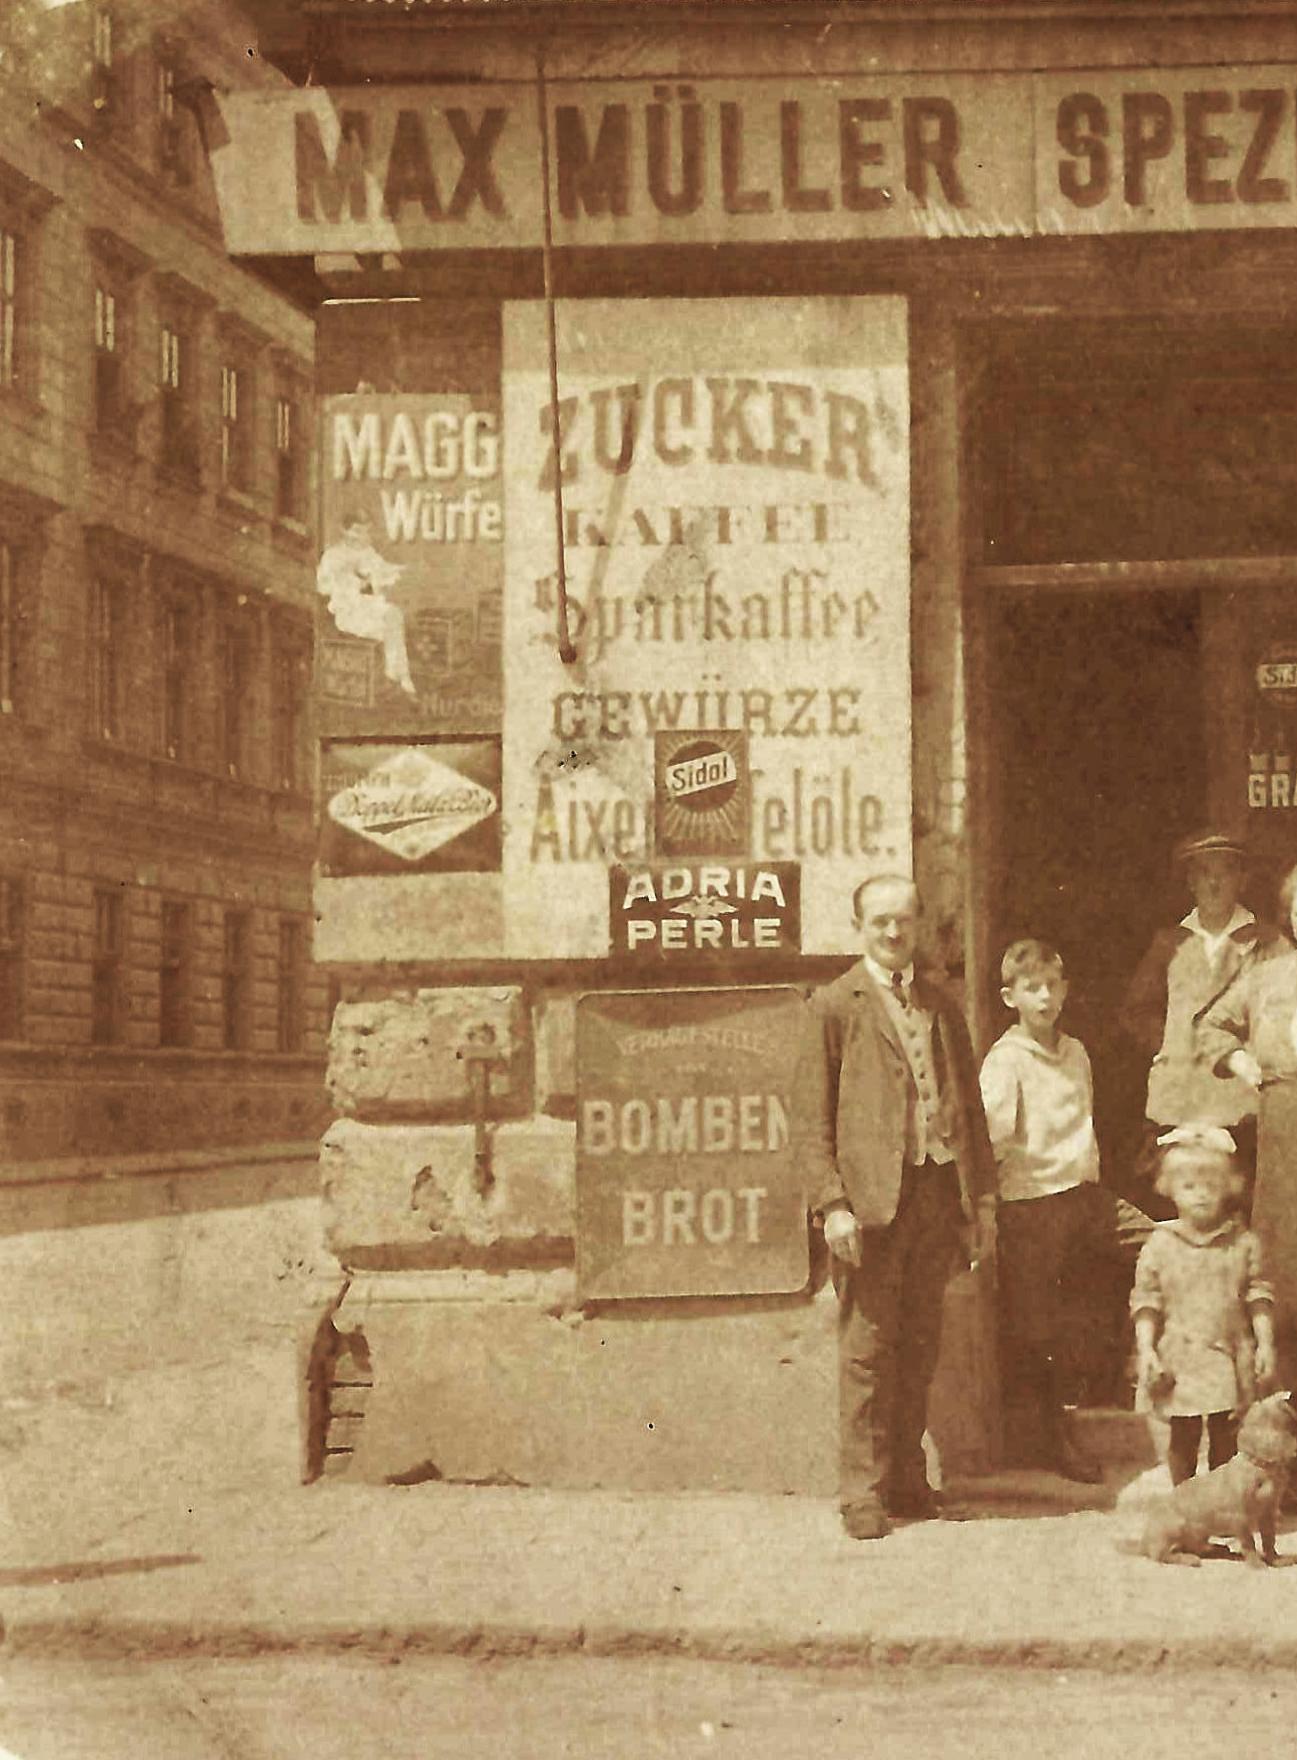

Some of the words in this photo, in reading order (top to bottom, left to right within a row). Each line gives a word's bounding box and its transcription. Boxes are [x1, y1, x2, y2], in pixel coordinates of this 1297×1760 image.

[292, 104, 511, 223] MAX
[553, 84, 965, 216] MÜLLER
[333, 411, 499, 481] MAGG
[537, 376, 884, 497] ZUCKER
[381, 487, 502, 542] Würfe
[552, 674, 862, 741] GEWÜRZE
[671, 758, 728, 792] Sidol
[623, 867, 787, 909] ADRIA
[626, 917, 782, 950] PERLE
[583, 1094, 791, 1155] BOMBEN
[621, 1187, 766, 1246] BROT
